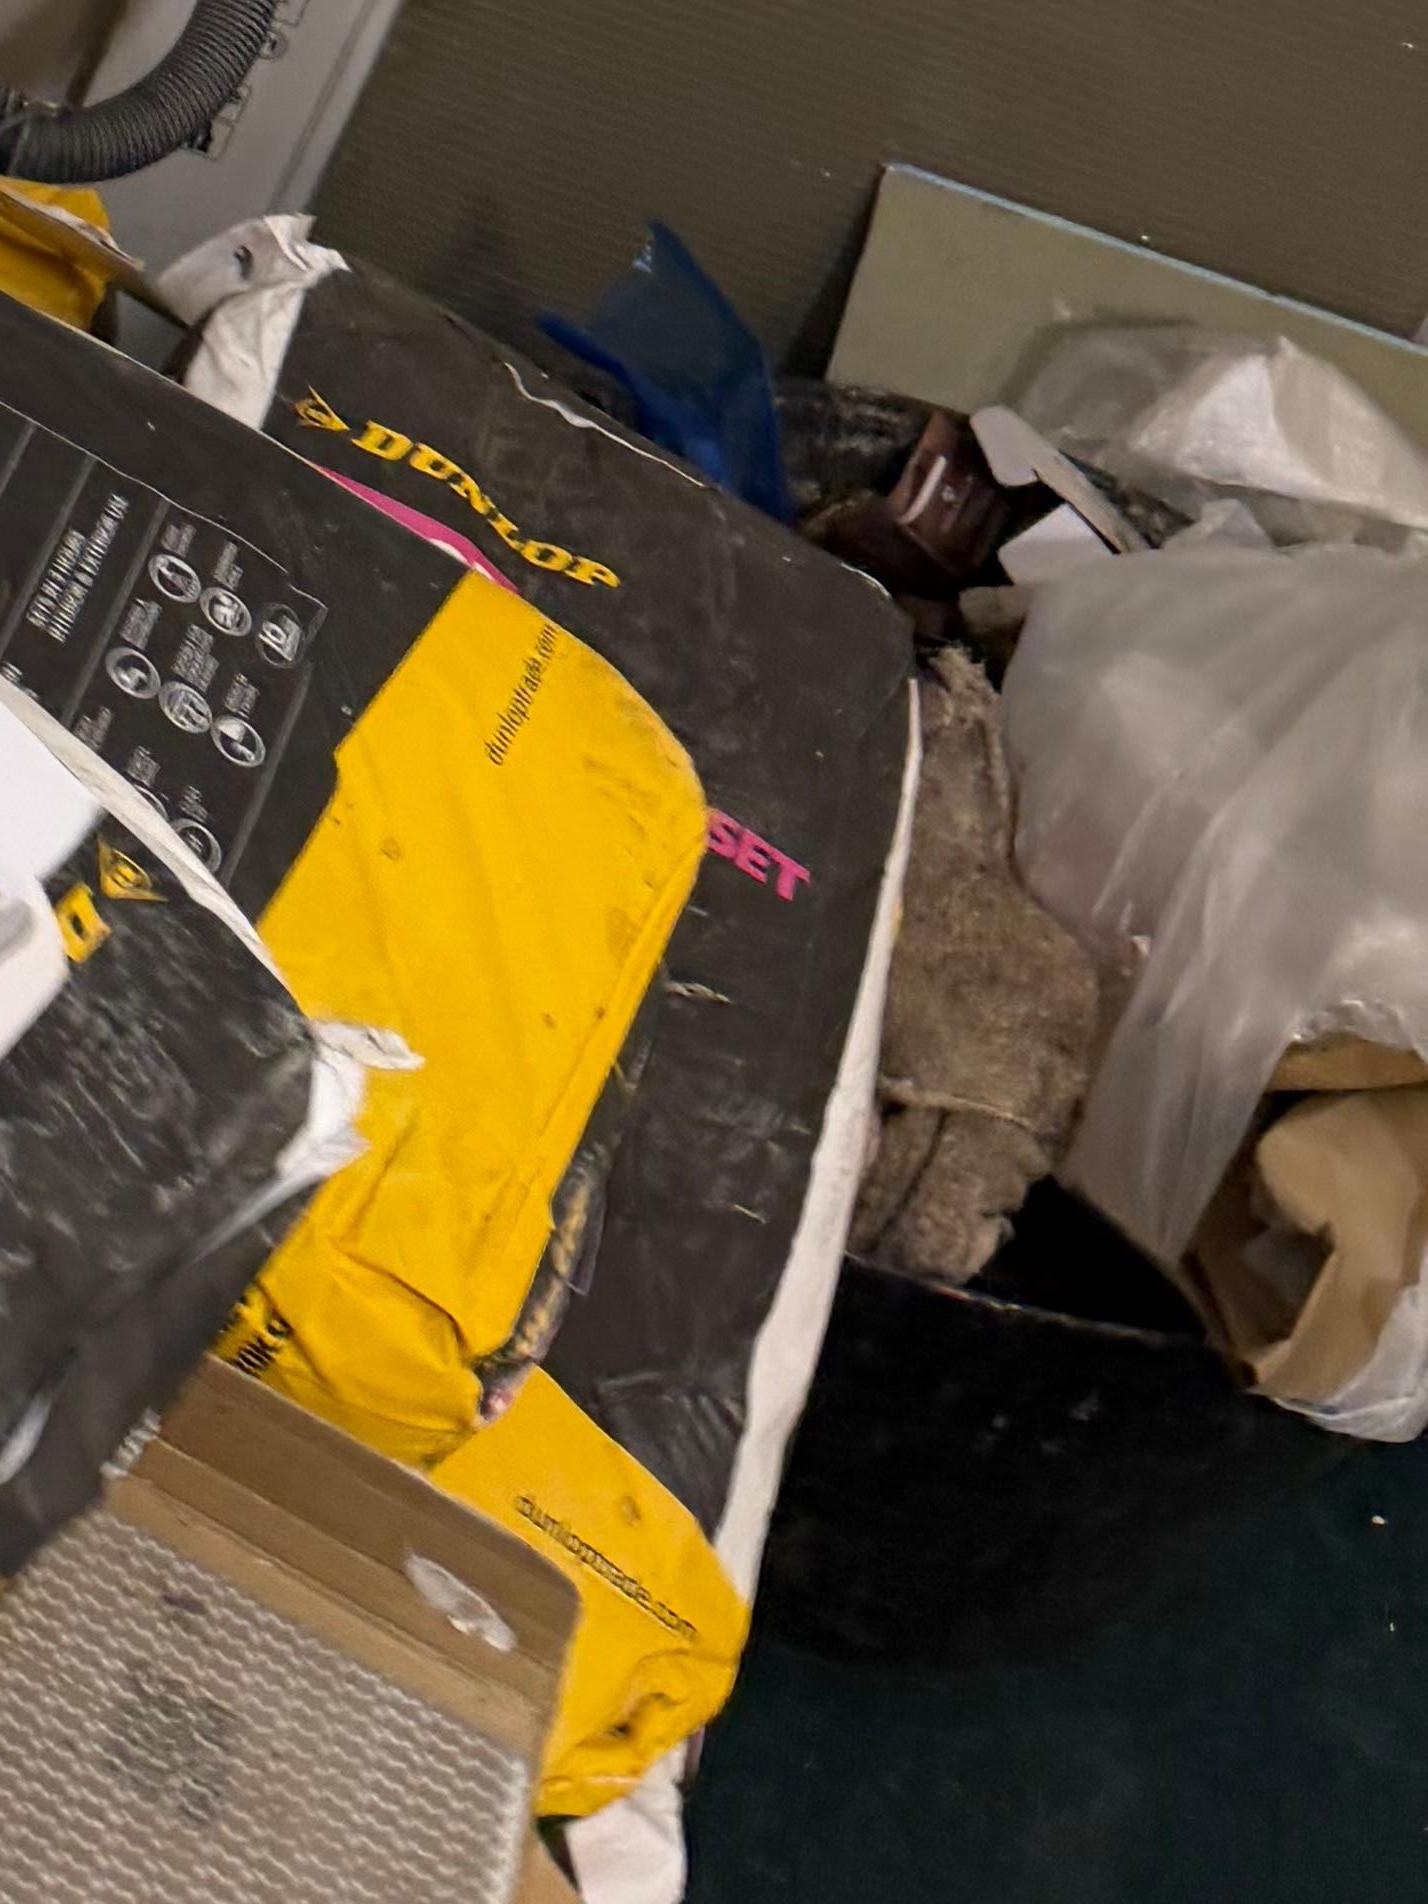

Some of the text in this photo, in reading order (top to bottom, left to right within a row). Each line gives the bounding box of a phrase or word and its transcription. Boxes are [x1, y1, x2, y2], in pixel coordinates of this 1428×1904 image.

[350, 421, 622, 588] DUNLOP
[486, 622, 559, 767] dunloptrade.com
[705, 806, 811, 902] SET
